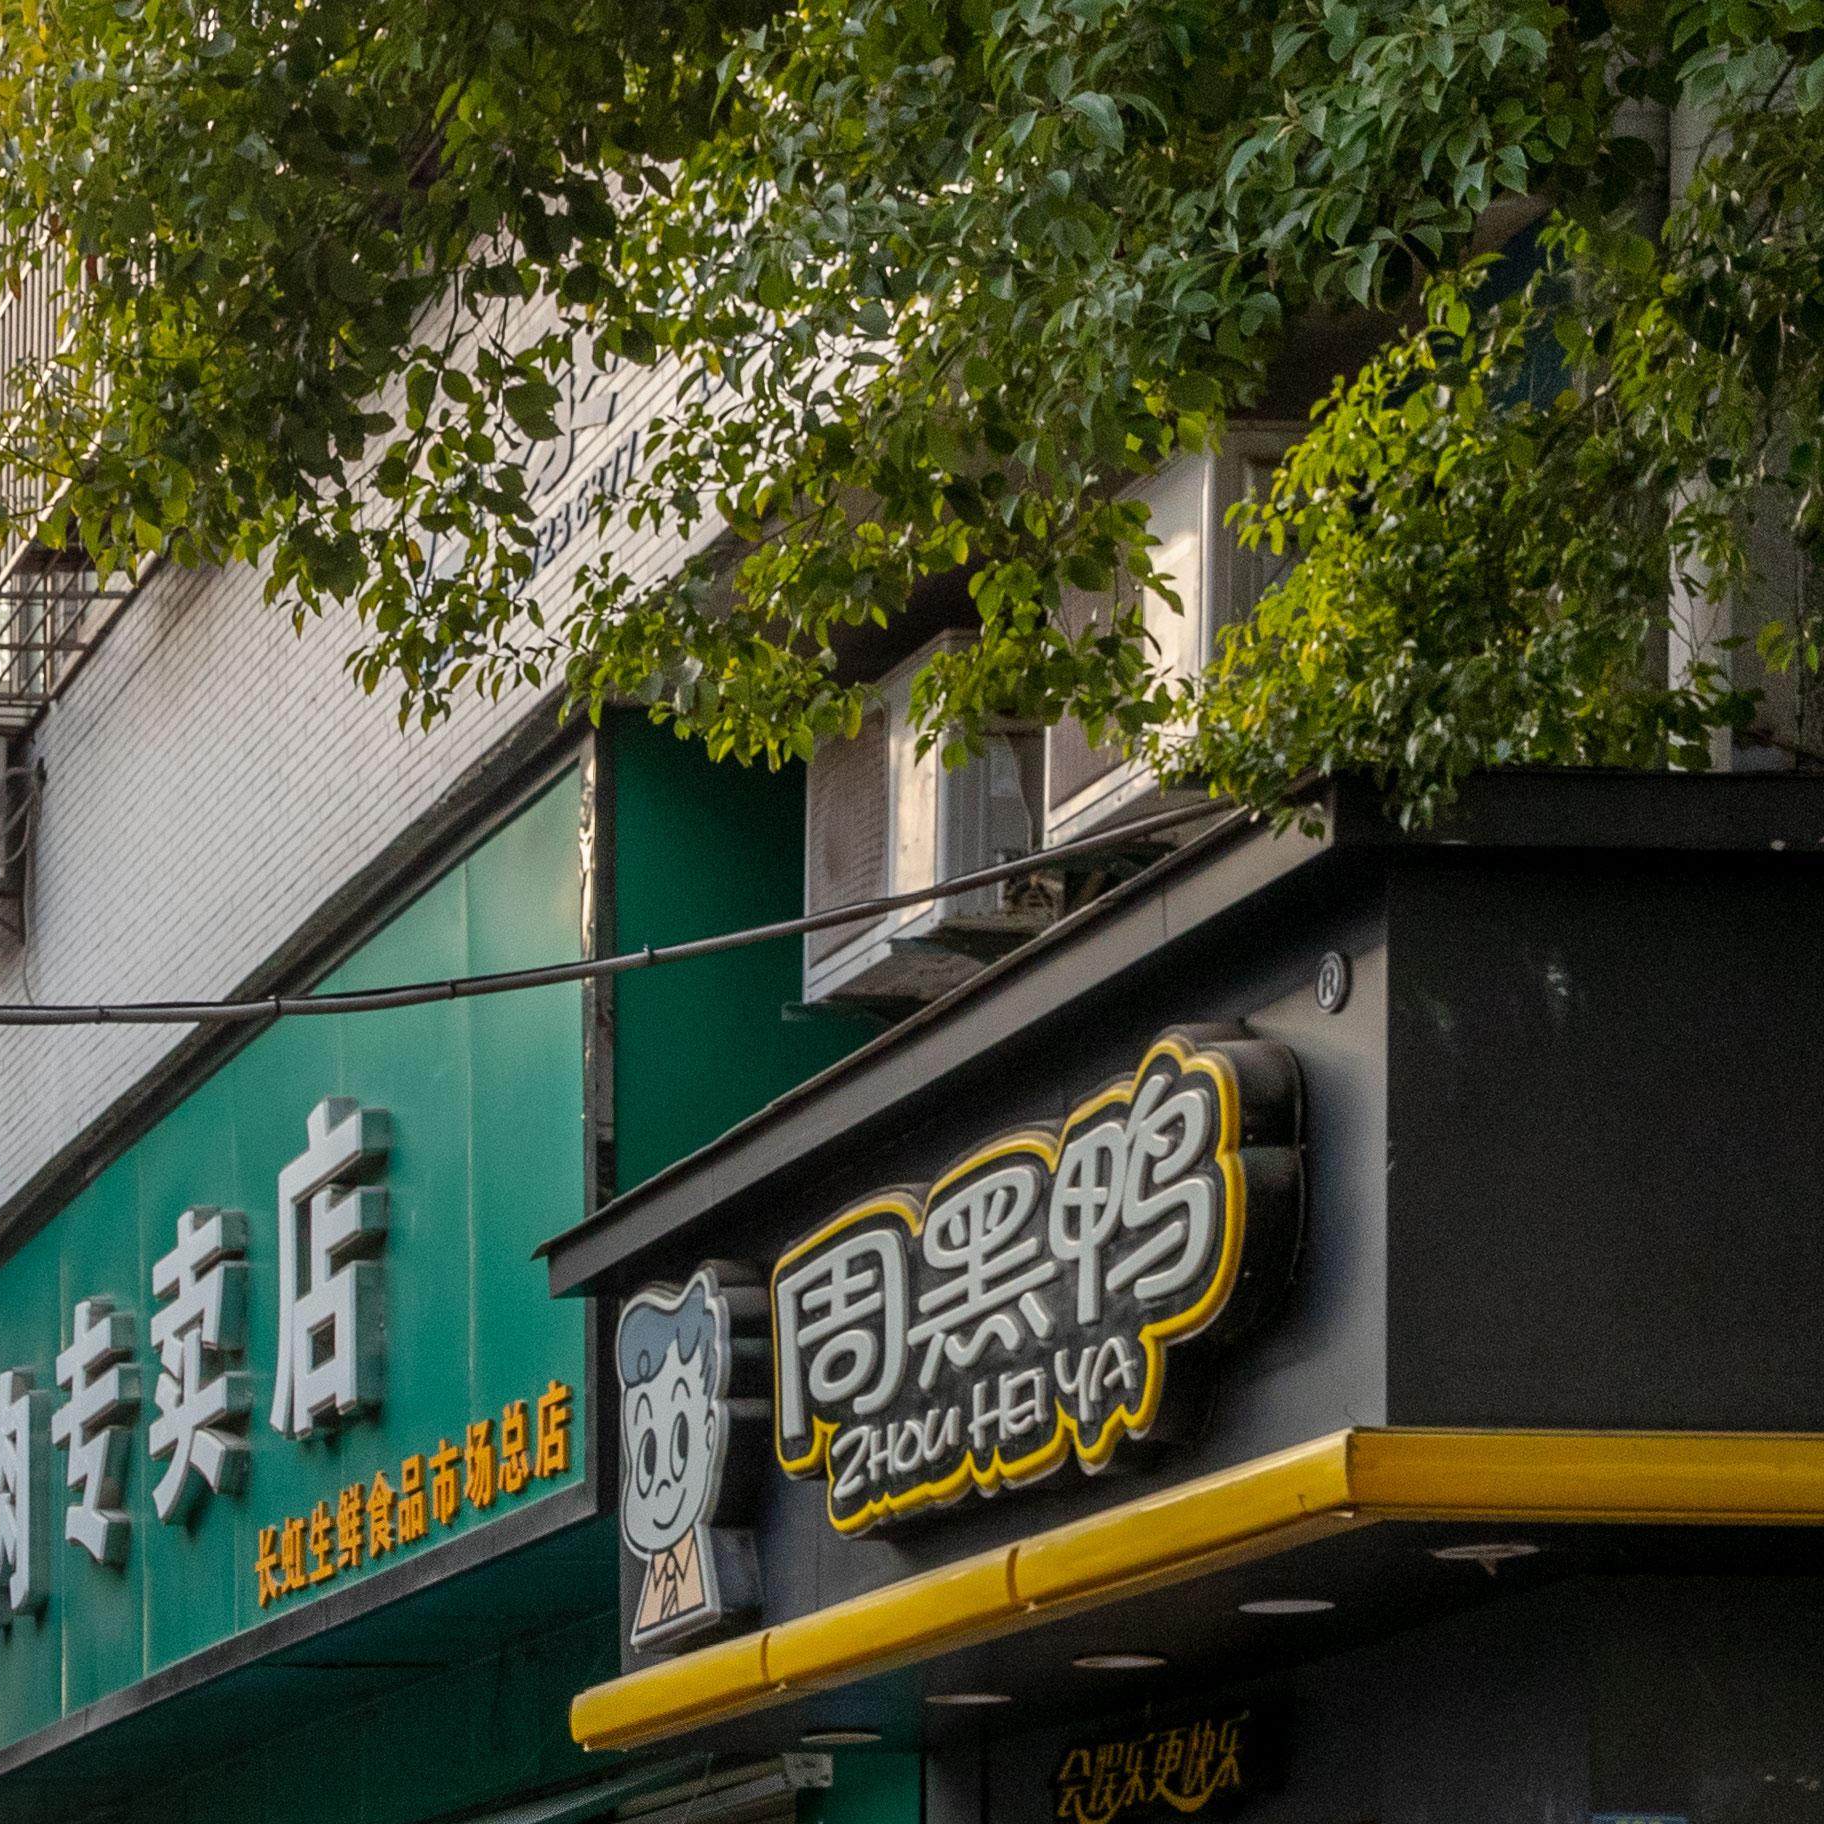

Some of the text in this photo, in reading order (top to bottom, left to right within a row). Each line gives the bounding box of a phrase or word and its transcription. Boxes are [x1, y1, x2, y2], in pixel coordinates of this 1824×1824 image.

[776, 1074, 1214, 1440] 周黑鸭
[255, 1380, 572, 1608] 长虹生鲜食品市场总店
[832, 1337, 1139, 1500] ZHOU HEI YA
